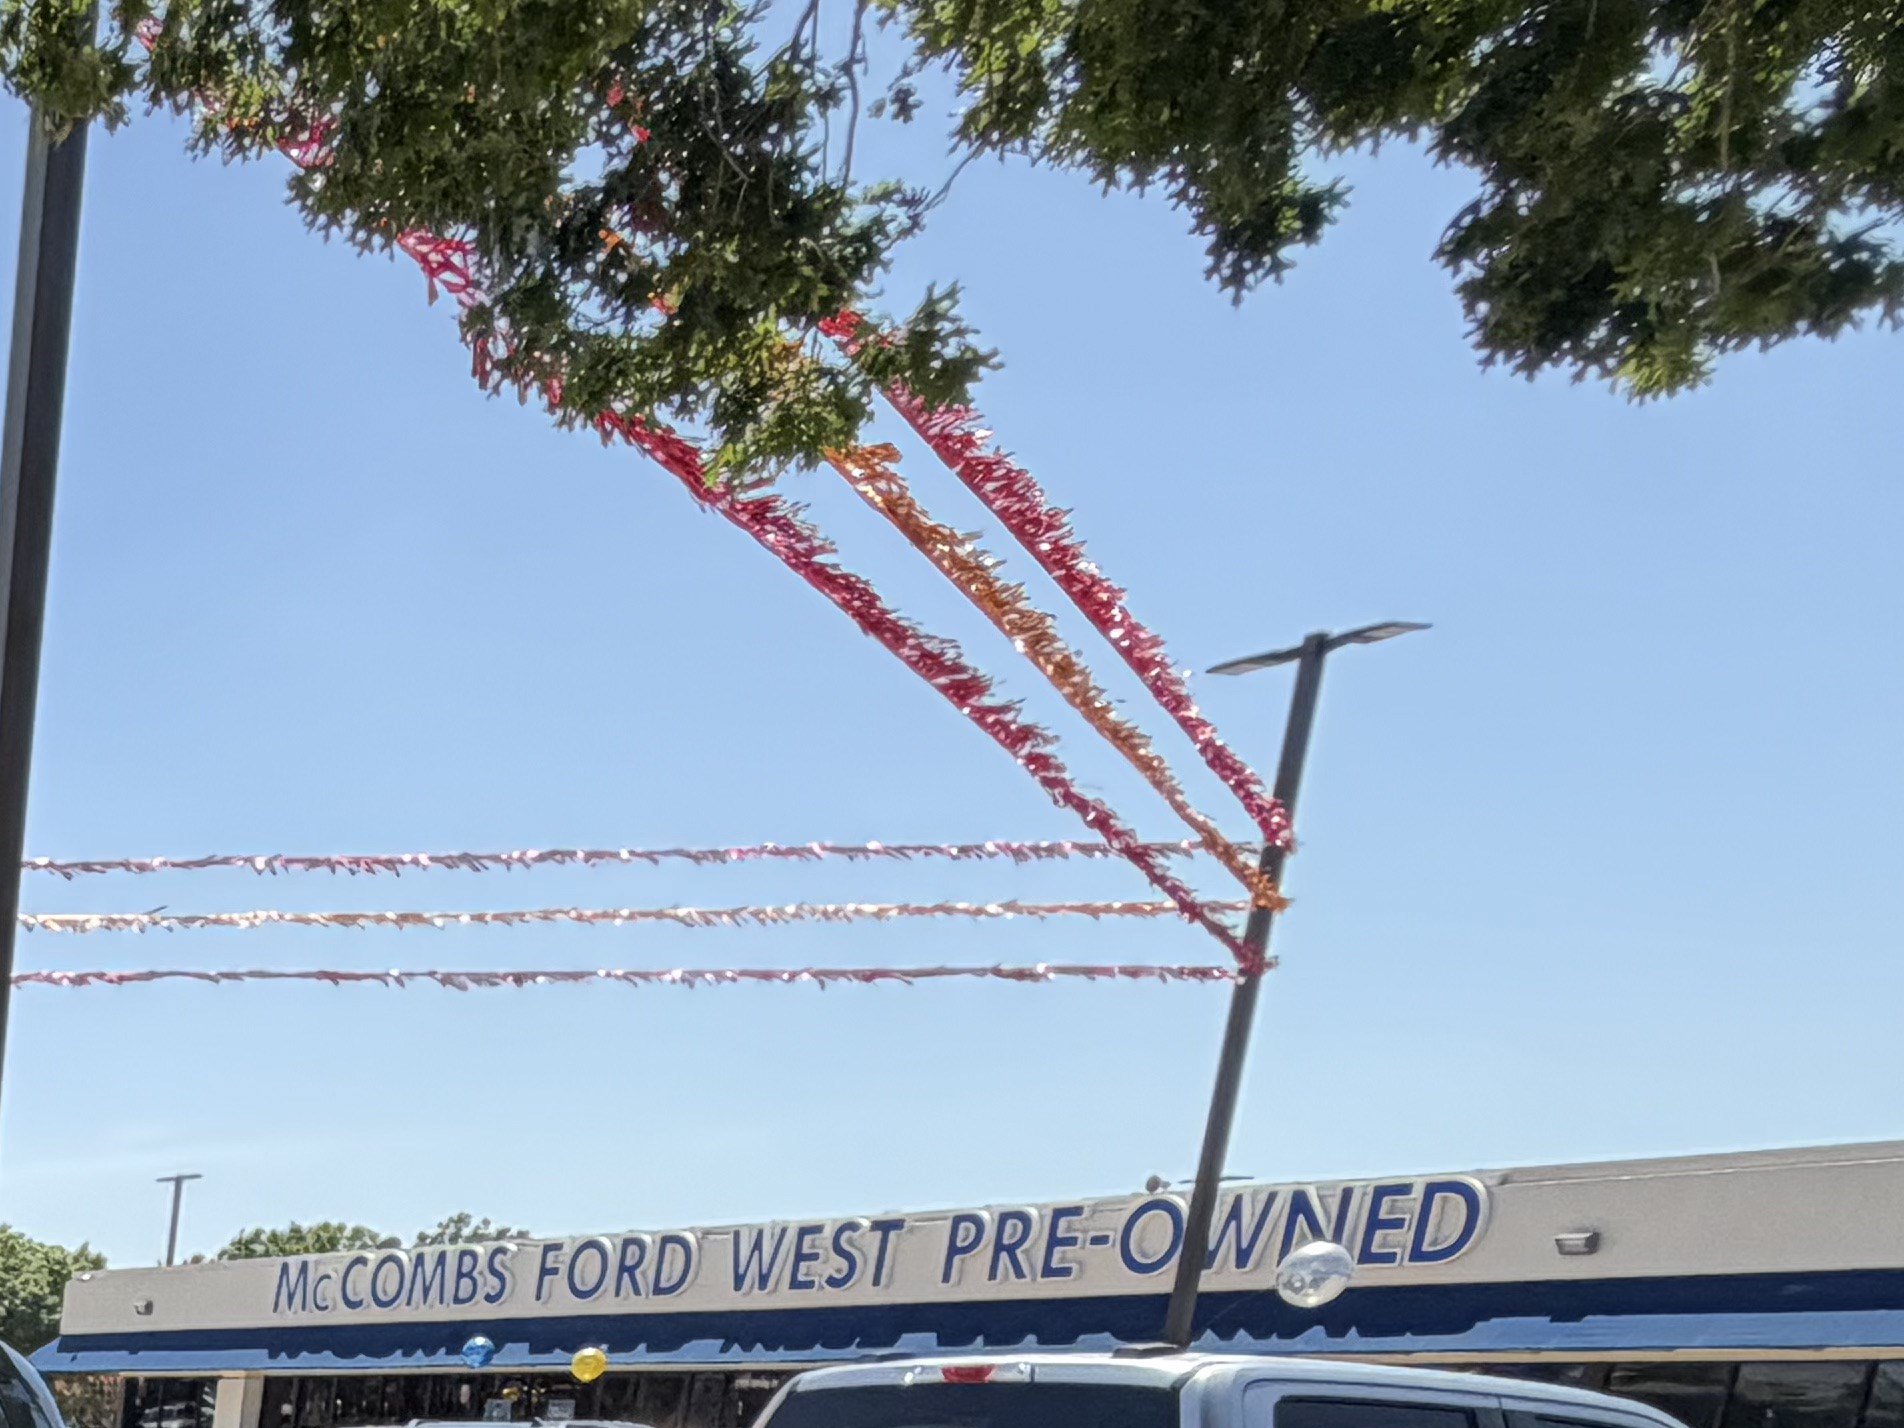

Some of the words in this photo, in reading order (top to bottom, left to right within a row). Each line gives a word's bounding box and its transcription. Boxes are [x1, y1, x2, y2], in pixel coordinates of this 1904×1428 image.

[271, 1244, 515, 1316] McCOMBS
[533, 1231, 698, 1303] FORD
[732, 1217, 906, 1293] WEST
[940, 1178, 1482, 1284] PRE-OWNED
